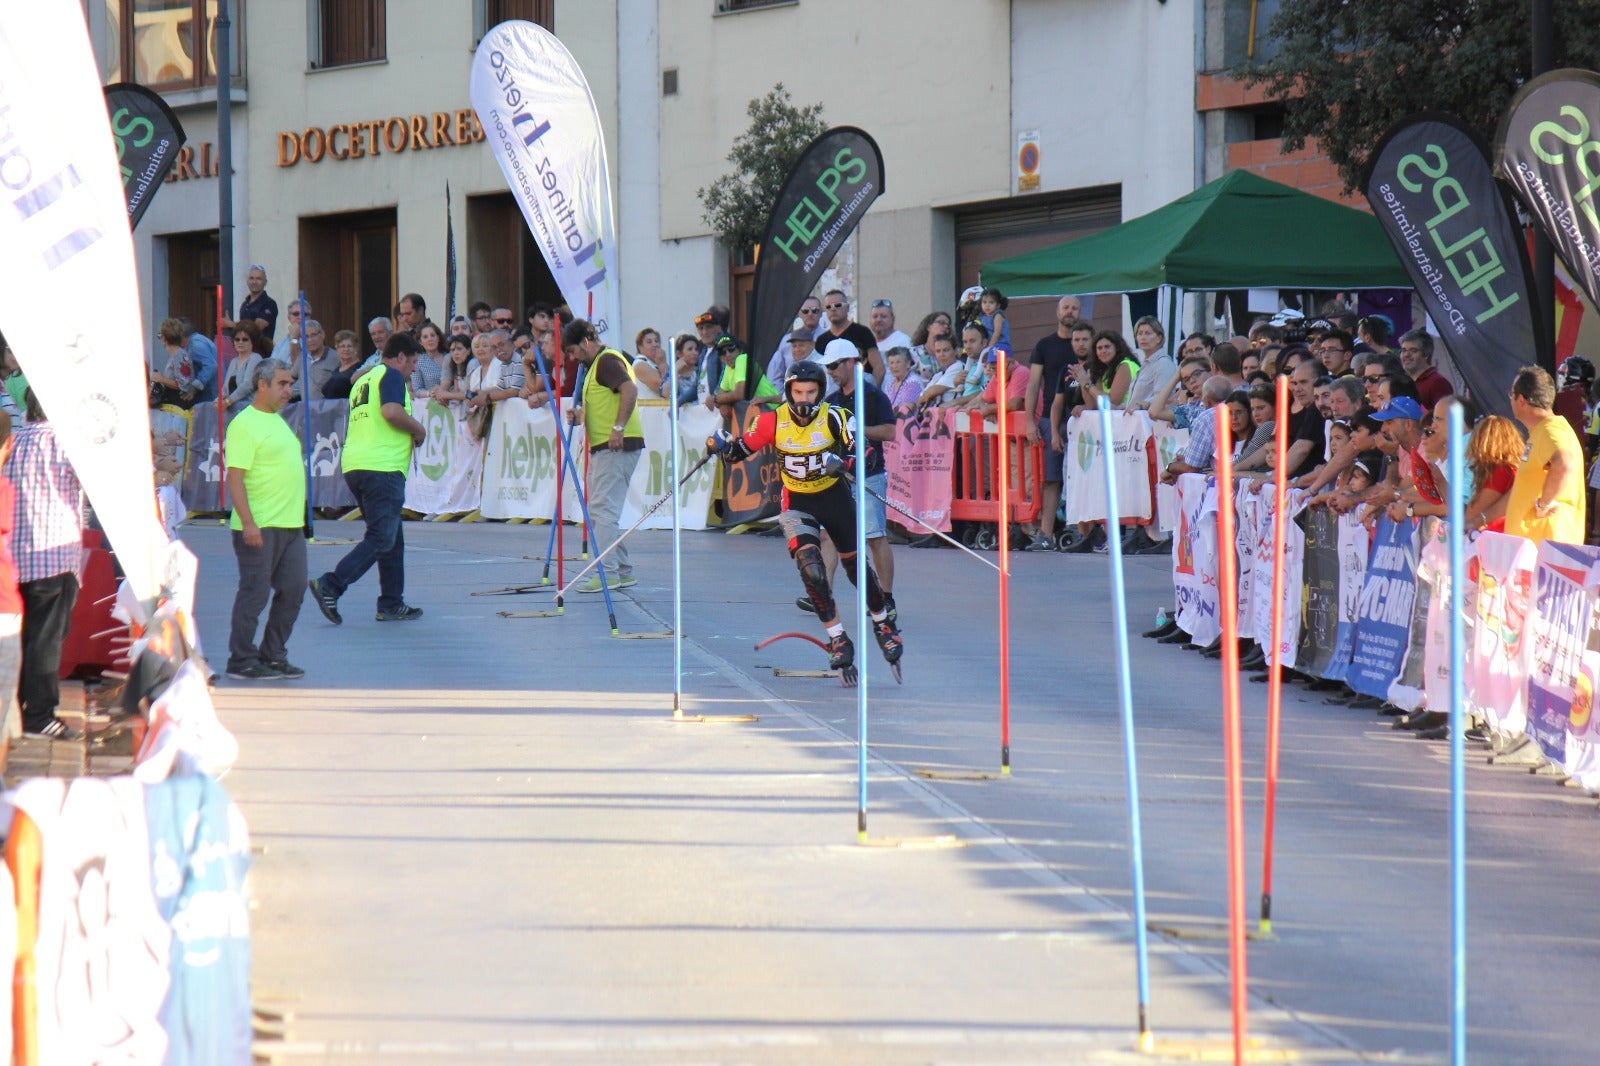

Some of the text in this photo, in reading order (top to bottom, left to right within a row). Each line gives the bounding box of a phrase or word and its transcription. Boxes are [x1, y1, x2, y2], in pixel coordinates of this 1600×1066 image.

[277, 109, 487, 167] DOCETORRES
[773, 147, 867, 263] HELPS
[803, 181, 873, 273] #Desafíatuslímites
[784, 452, 831, 479] 54
